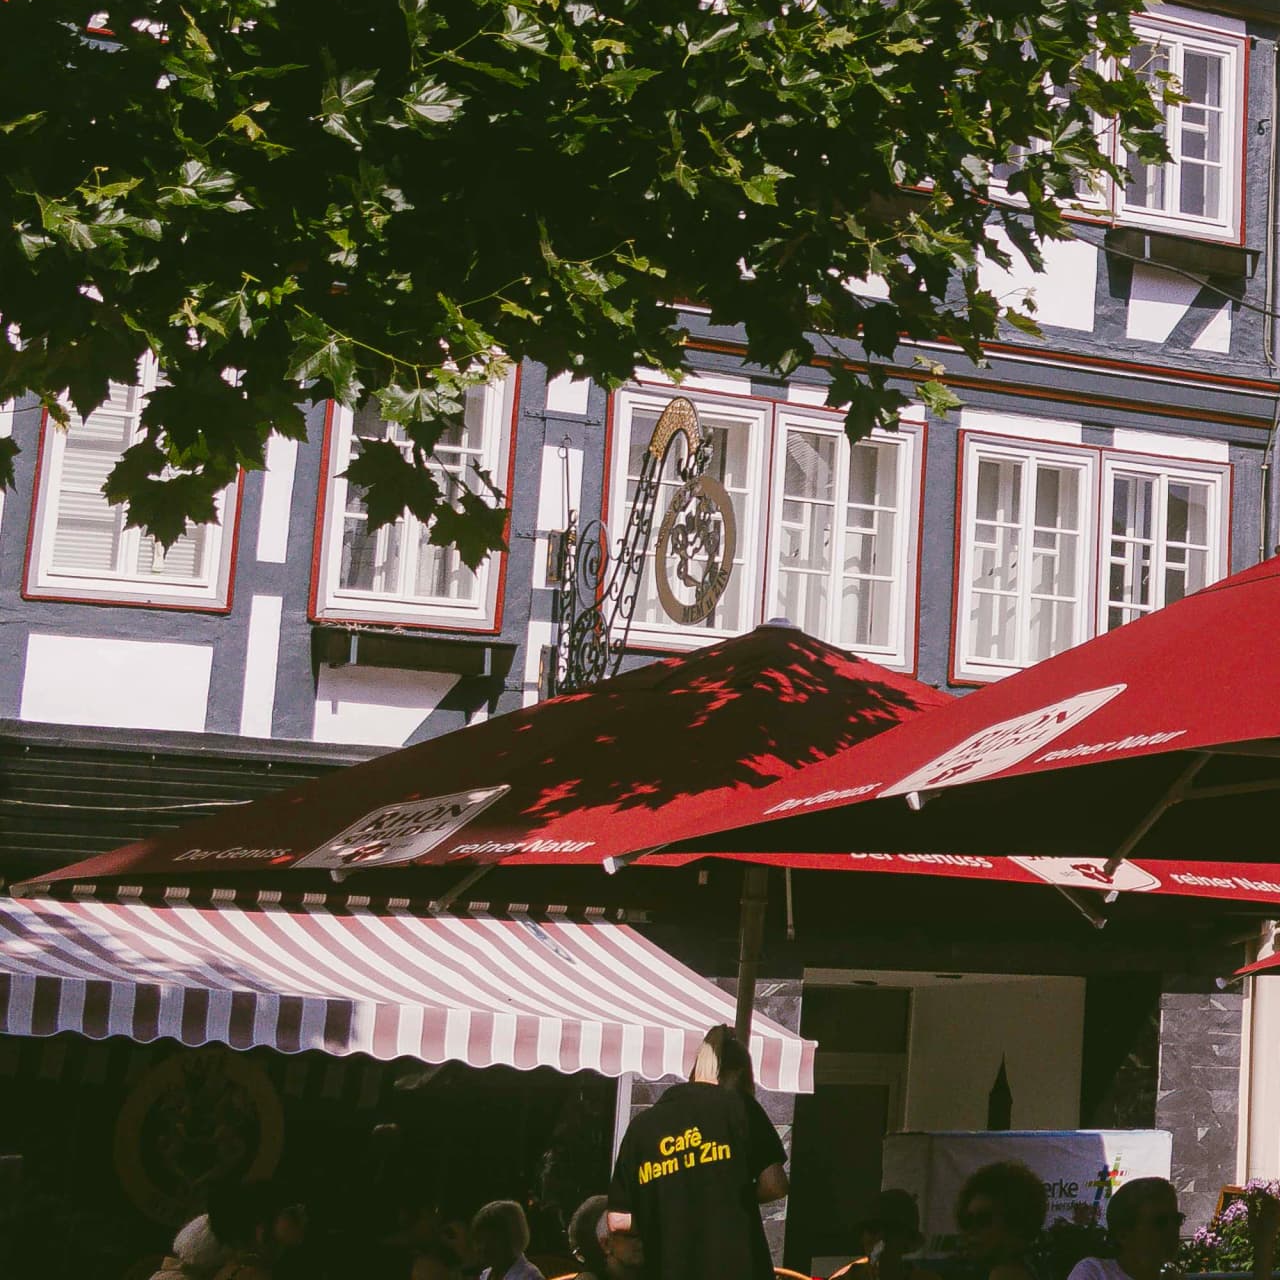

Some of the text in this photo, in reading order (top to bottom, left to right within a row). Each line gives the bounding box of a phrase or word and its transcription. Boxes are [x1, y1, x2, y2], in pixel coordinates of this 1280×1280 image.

[1034, 742, 1114, 764] reiner
[1110, 729, 1188, 753] Natur
[173, 837, 597, 861] Der Genuss reiner Natur
[1171, 871, 1238, 890] reiner
[638, 1141, 731, 1185] Mem u Zin
